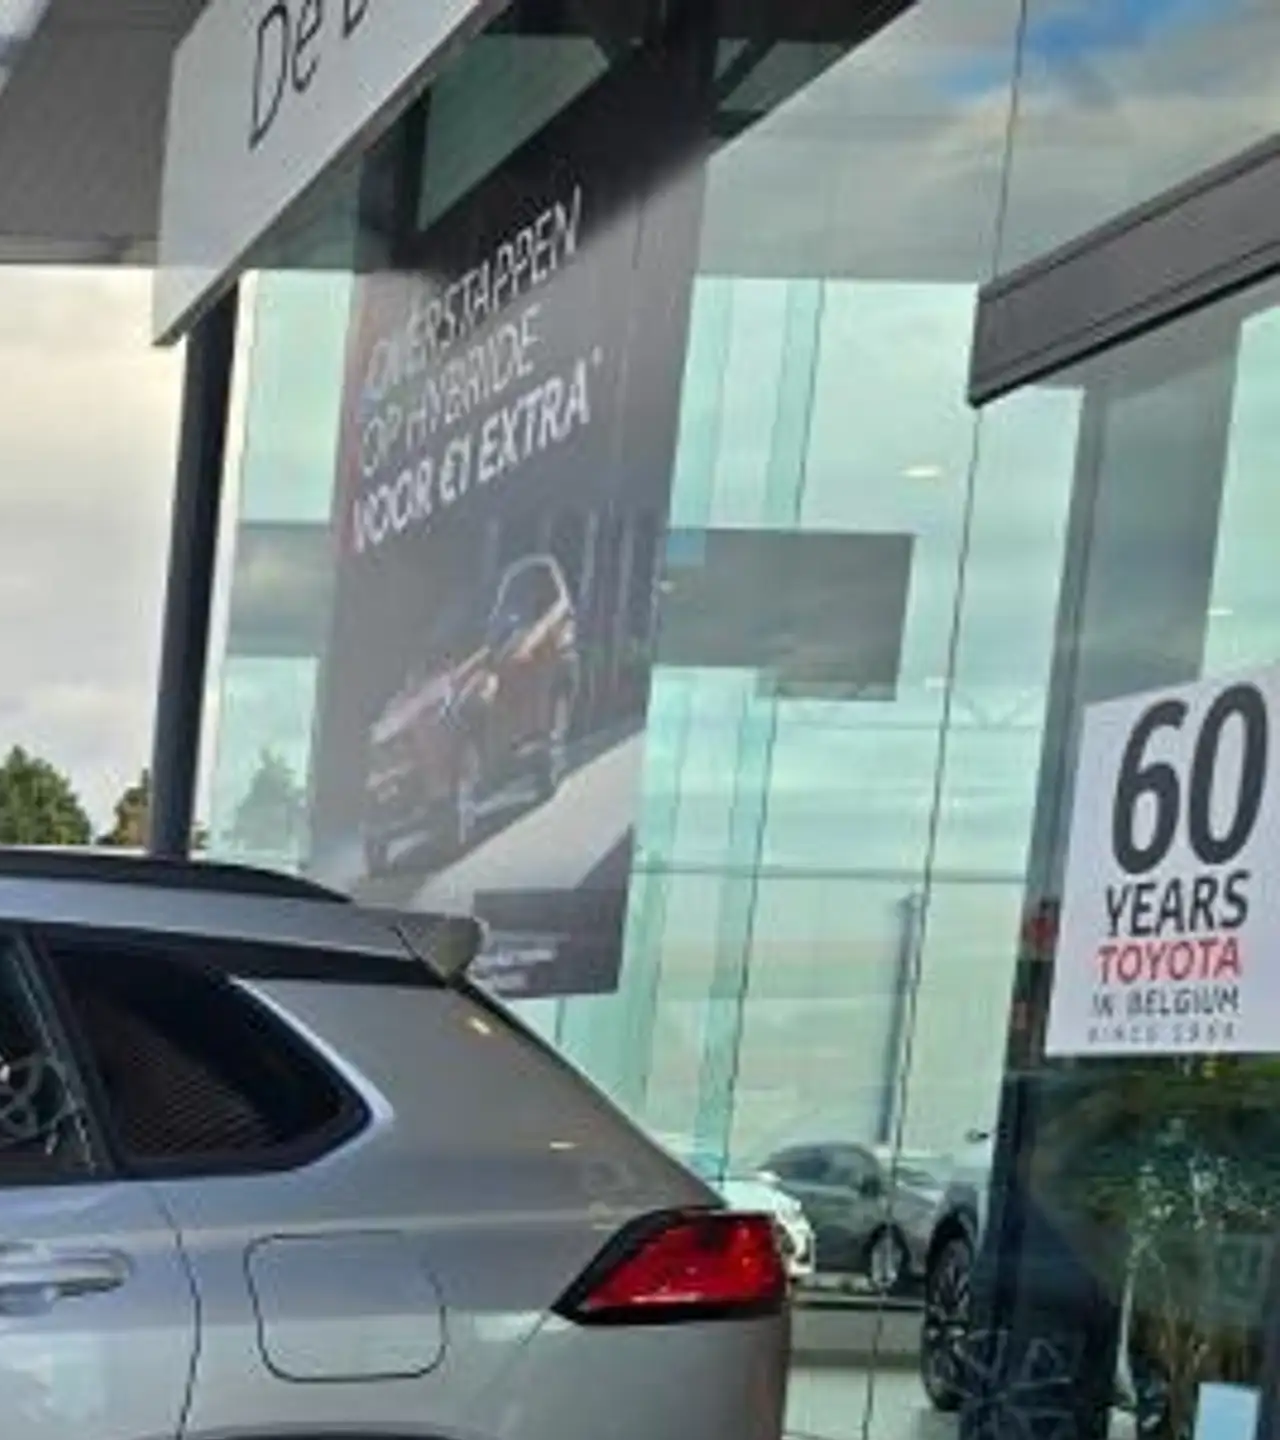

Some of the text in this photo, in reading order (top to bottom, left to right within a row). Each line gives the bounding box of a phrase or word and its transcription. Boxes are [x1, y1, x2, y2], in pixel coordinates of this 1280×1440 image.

[1112, 681, 1268, 875] 60
[1105, 869, 1251, 938] YEARS
[1097, 936, 1243, 984] TOYOTA
[1126, 984, 1240, 1017] BELGIUM
